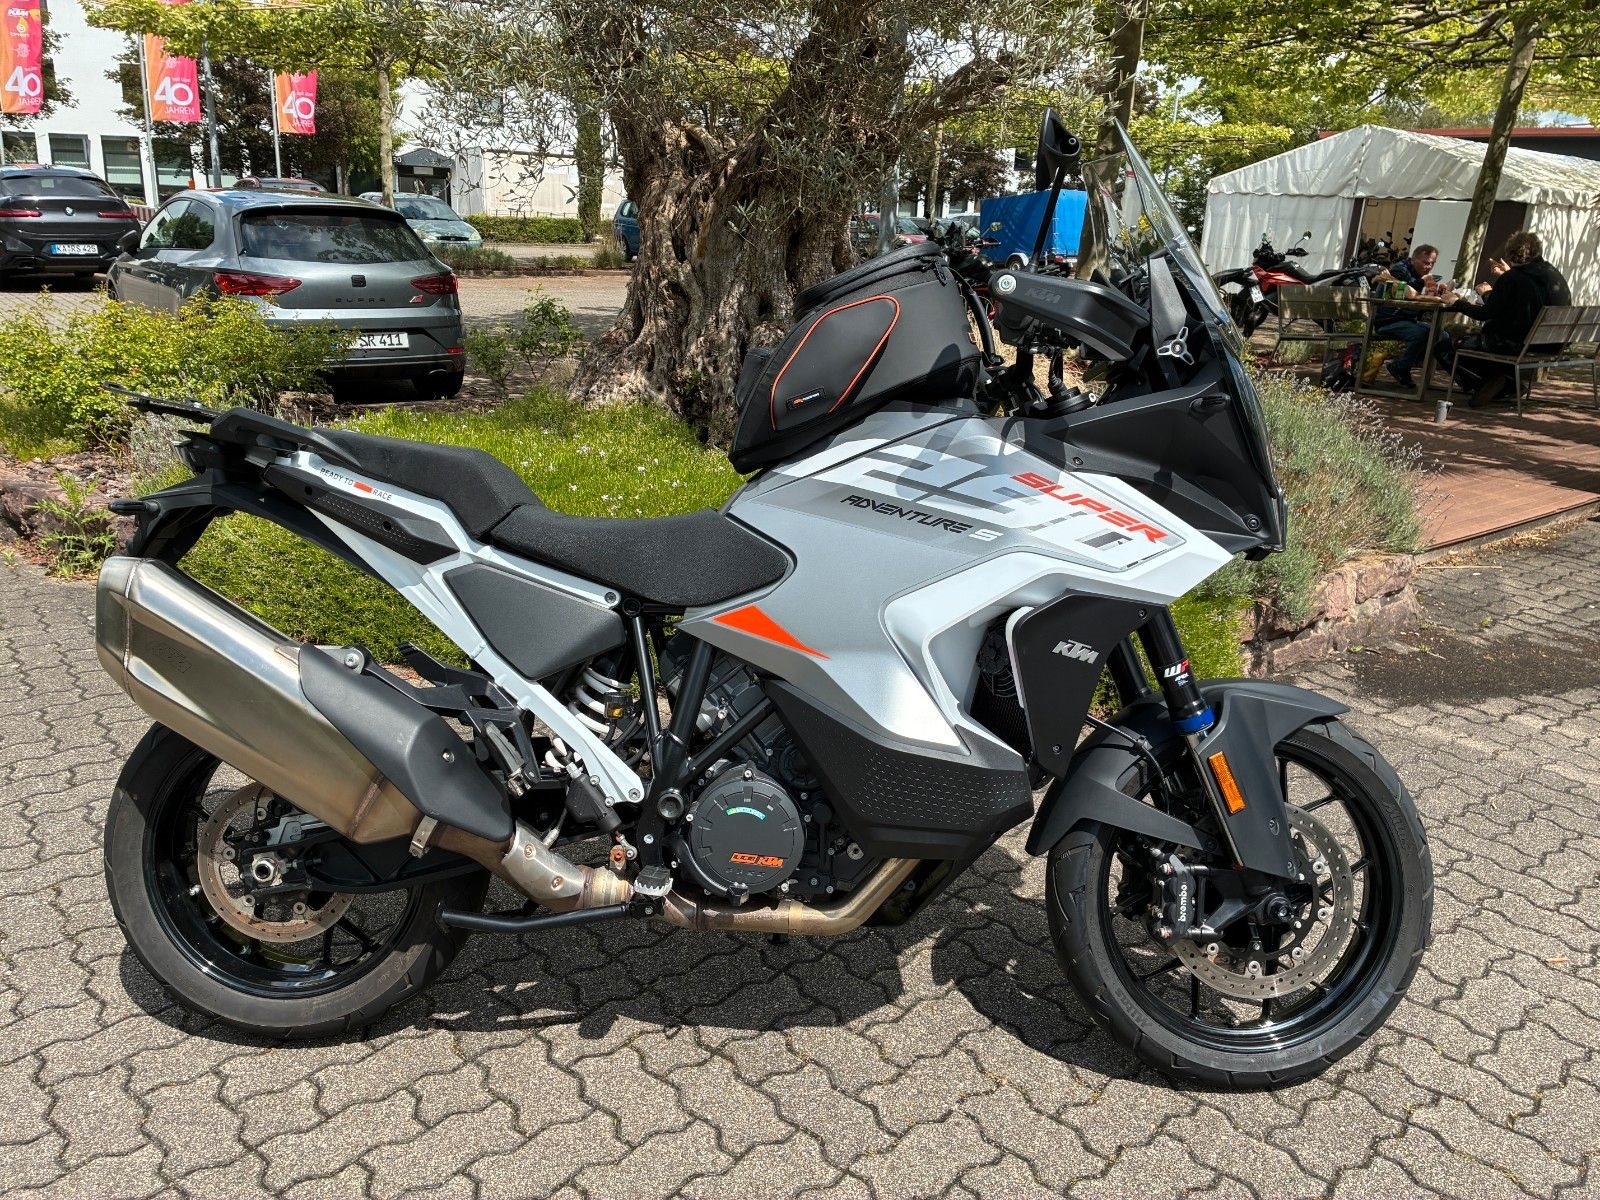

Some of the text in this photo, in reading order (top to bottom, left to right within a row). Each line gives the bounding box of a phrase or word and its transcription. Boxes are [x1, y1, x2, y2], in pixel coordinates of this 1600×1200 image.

[5, 66, 41, 97] 40
[154, 76, 194, 106] 40
[165, 106, 195, 115] JAHREN
[282, 90, 315, 120] 40
[379, 333, 403, 347] 411
[320, 467, 393, 502] READY TO RACE
[840, 494, 1004, 542] ADVENTURE S
[1010, 472, 1169, 544] SUPER
[1051, 639, 1100, 665] KTM
[1163, 659, 1190, 678] WP
[1178, 884, 1188, 922] brembo
